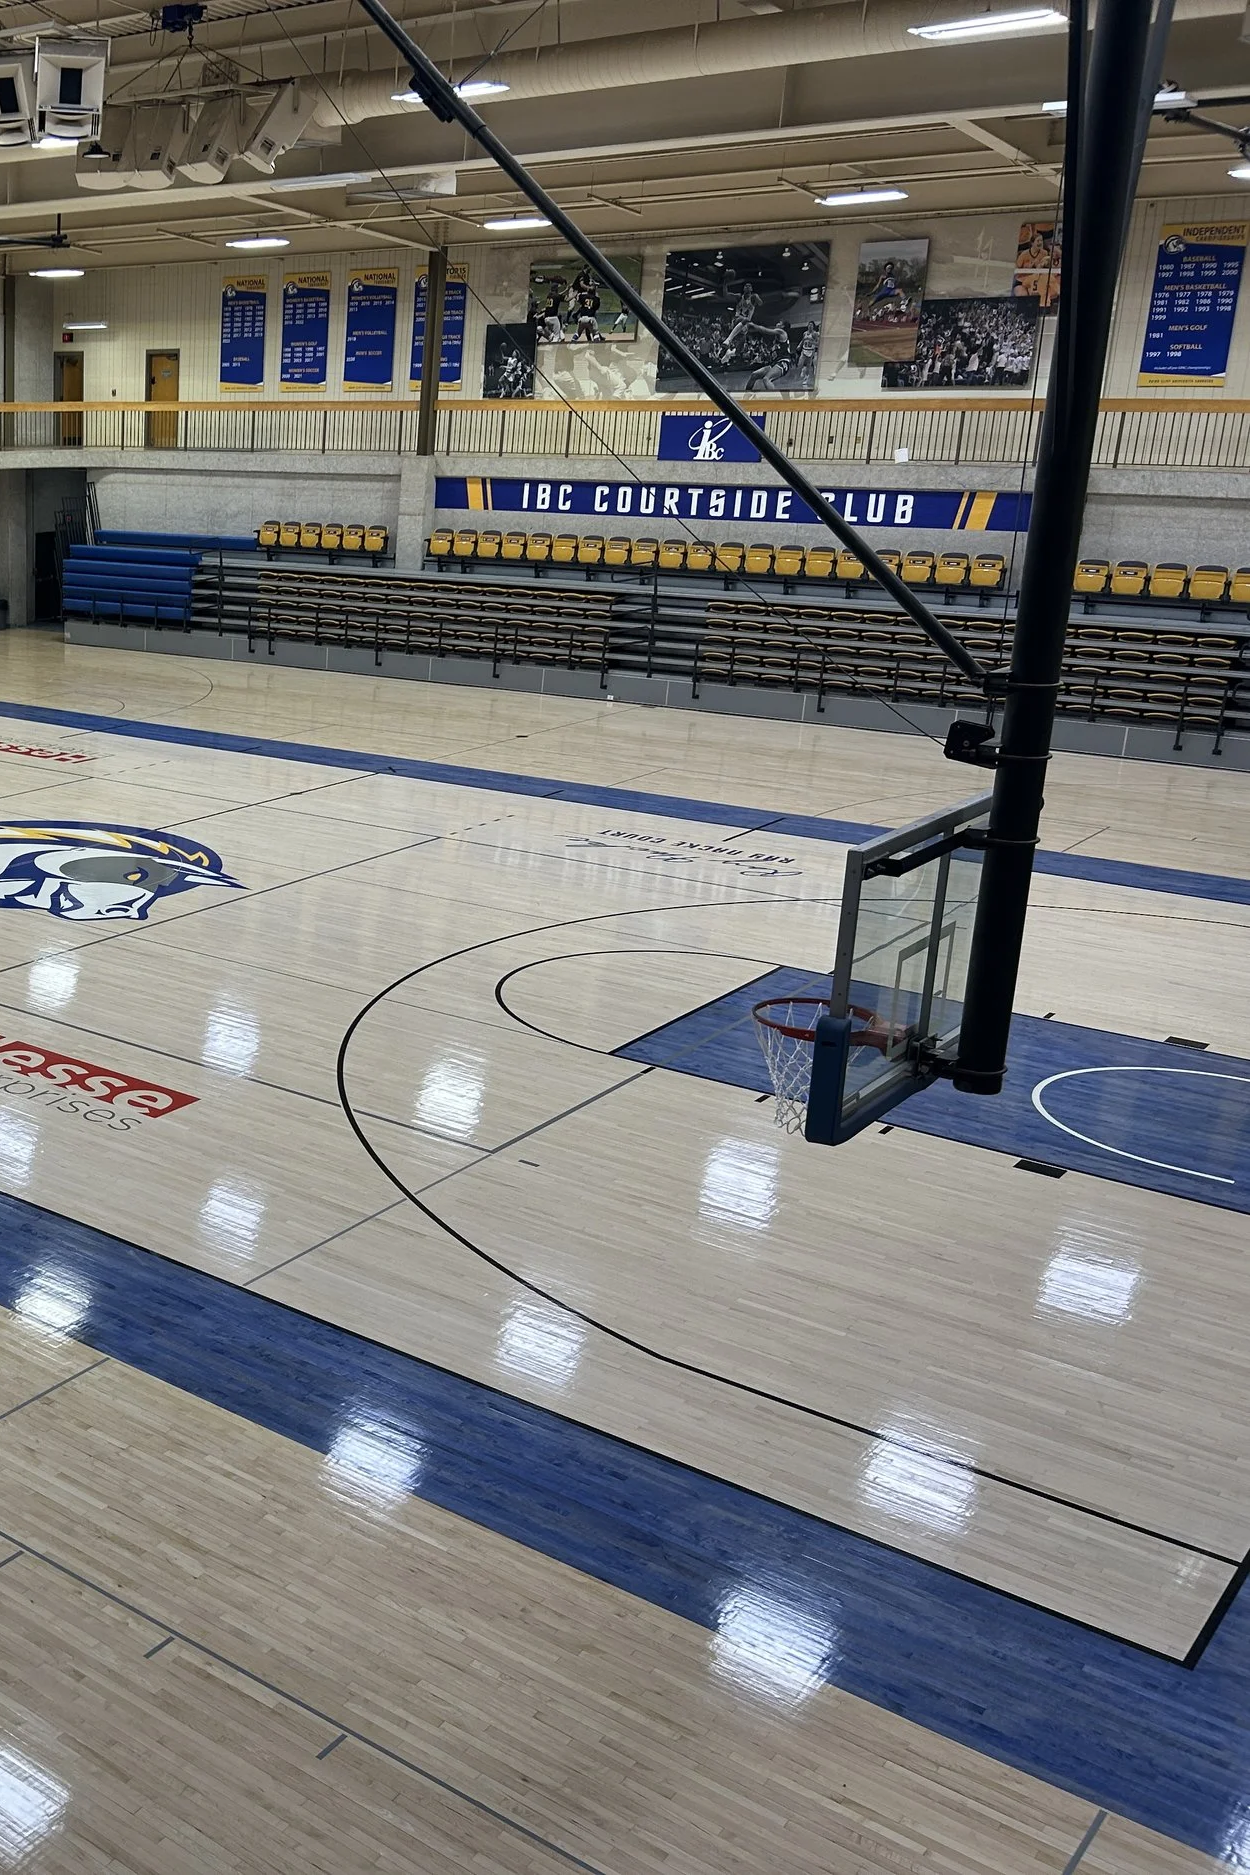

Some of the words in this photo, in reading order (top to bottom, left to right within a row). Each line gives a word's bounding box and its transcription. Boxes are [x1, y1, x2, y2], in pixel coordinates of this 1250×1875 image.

[1183, 225, 1246, 236] INDEPENDENT
[521, 482, 574, 511] IBC
[594, 485, 793, 520] COURTSIDE
